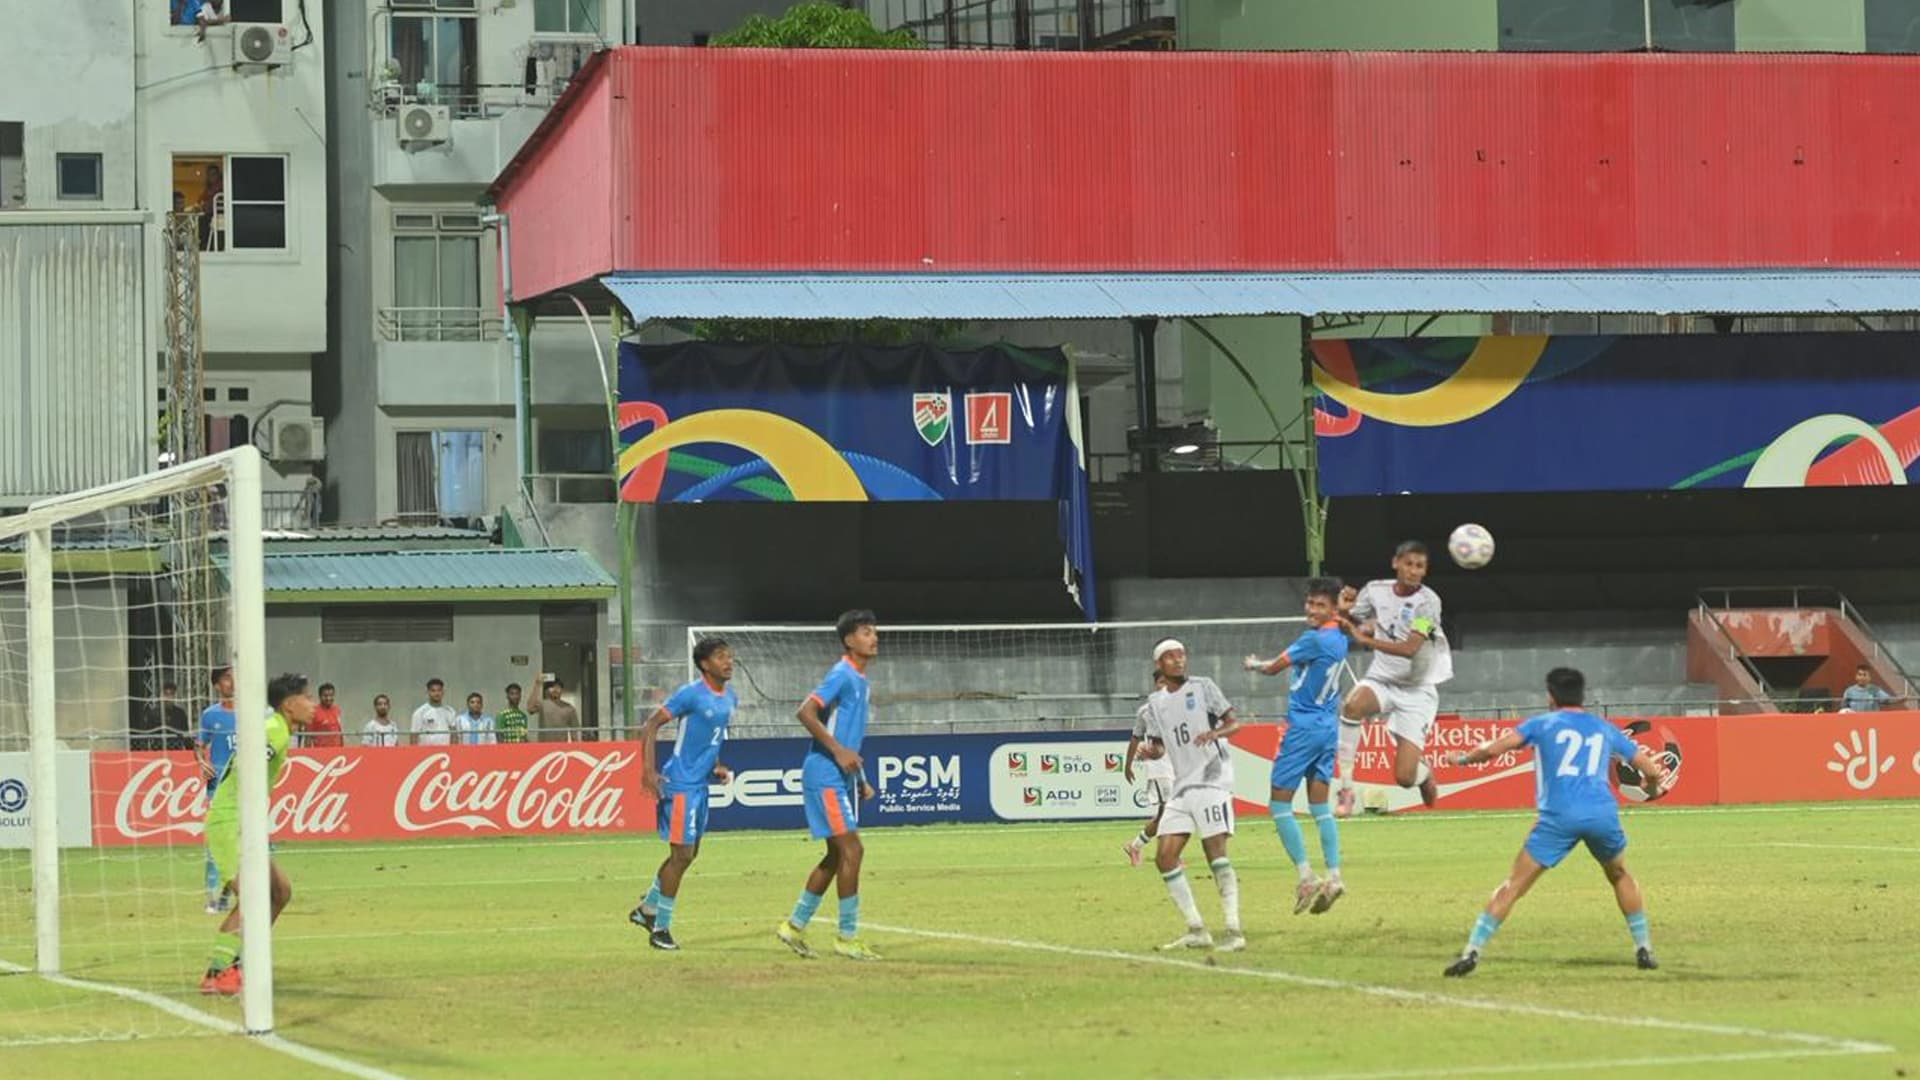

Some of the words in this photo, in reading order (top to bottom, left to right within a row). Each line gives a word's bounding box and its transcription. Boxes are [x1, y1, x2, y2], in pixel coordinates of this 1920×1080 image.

[1173, 722, 1190, 747] 16
[1555, 729, 1604, 777] 21
[878, 755, 960, 789] PSM
[1063, 762, 1092, 774] 91.0
[394, 750, 636, 831] Coca-Cola
[1046, 790, 1082, 800] ADU
[880, 804, 904, 813] Public
[906, 803, 935, 812] Service
[937, 802, 961, 811] Media
[1204, 805, 1222, 824] 16
